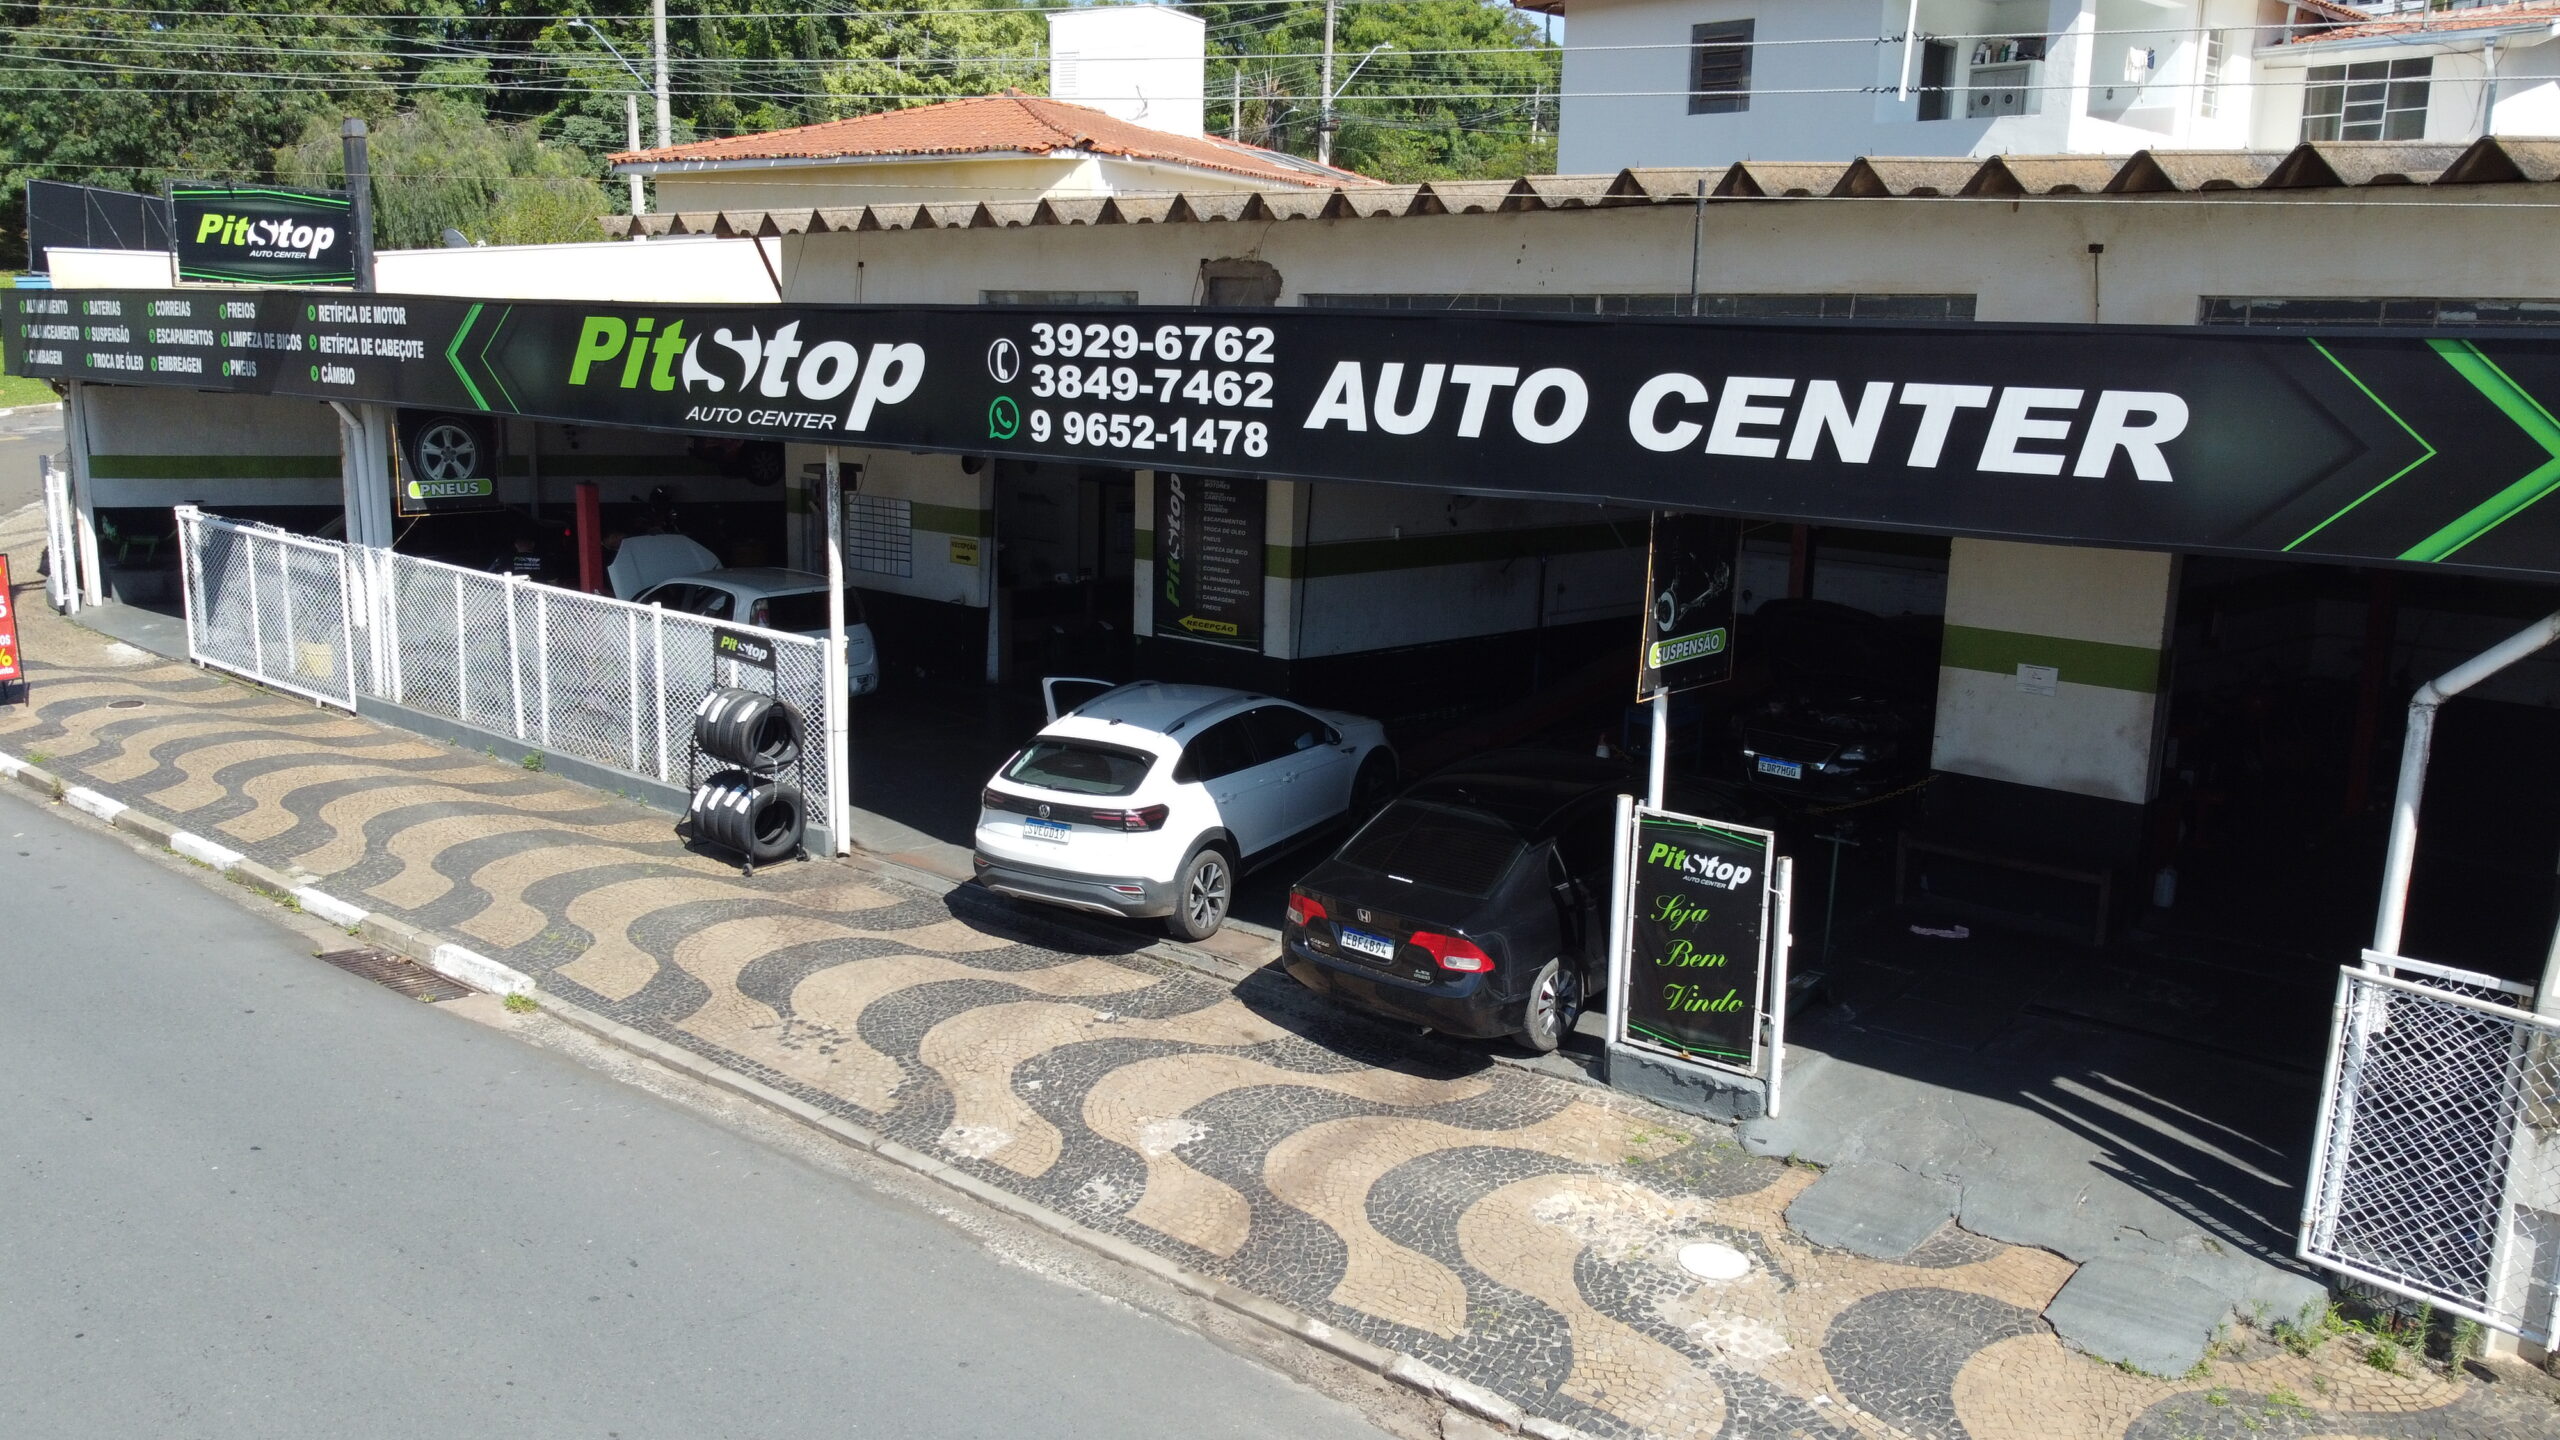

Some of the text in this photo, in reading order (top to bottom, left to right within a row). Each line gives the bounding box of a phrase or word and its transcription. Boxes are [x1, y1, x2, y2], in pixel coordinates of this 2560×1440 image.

[250, 250, 306, 259] AUTO CENTER
[89, 300, 121, 316] BATERIAS
[155, 300, 191, 317] CORREIAS
[226, 302, 256, 319] FREIOS
[318, 301, 407, 325] RETÍFICA DE MOTOR
[28, 324, 80, 341] BALANCEAMENTO
[91, 325, 130, 343] SUSPENSÃO
[156, 328, 214, 346] ESCAPAMENTOS
[228, 331, 302, 351] LIMPEZA DE BICOS
[1031, 323, 1274, 363] 3929-6762
[320, 332, 424, 362] RETÍFICA DE CABEÇOTE
[92, 351, 144, 371] TROCA DE ÓLEO
[230, 359, 257, 377] PNEUS
[321, 362, 355, 385] CÂMBIO
[1031, 364, 1274, 409] 3849-7462
[685, 406, 837, 430] AUTO CENTER
[1303, 361, 2190, 482] AUTO CENTER
[1030, 409, 1268, 458] 9 9652-1478
[420, 482, 479, 496] PNEUS
[1186, 619, 1234, 633] RECEPÇÃO
[1655, 634, 1719, 664] SUSPENSÃO
[1682, 874, 1727, 889] AUTO CENTER
[1650, 894, 1711, 932] Seja
[1345, 933, 1387, 956] EBF4B94
[1655, 939, 1729, 968] Bem
[1662, 983, 1745, 1013] Vindo
